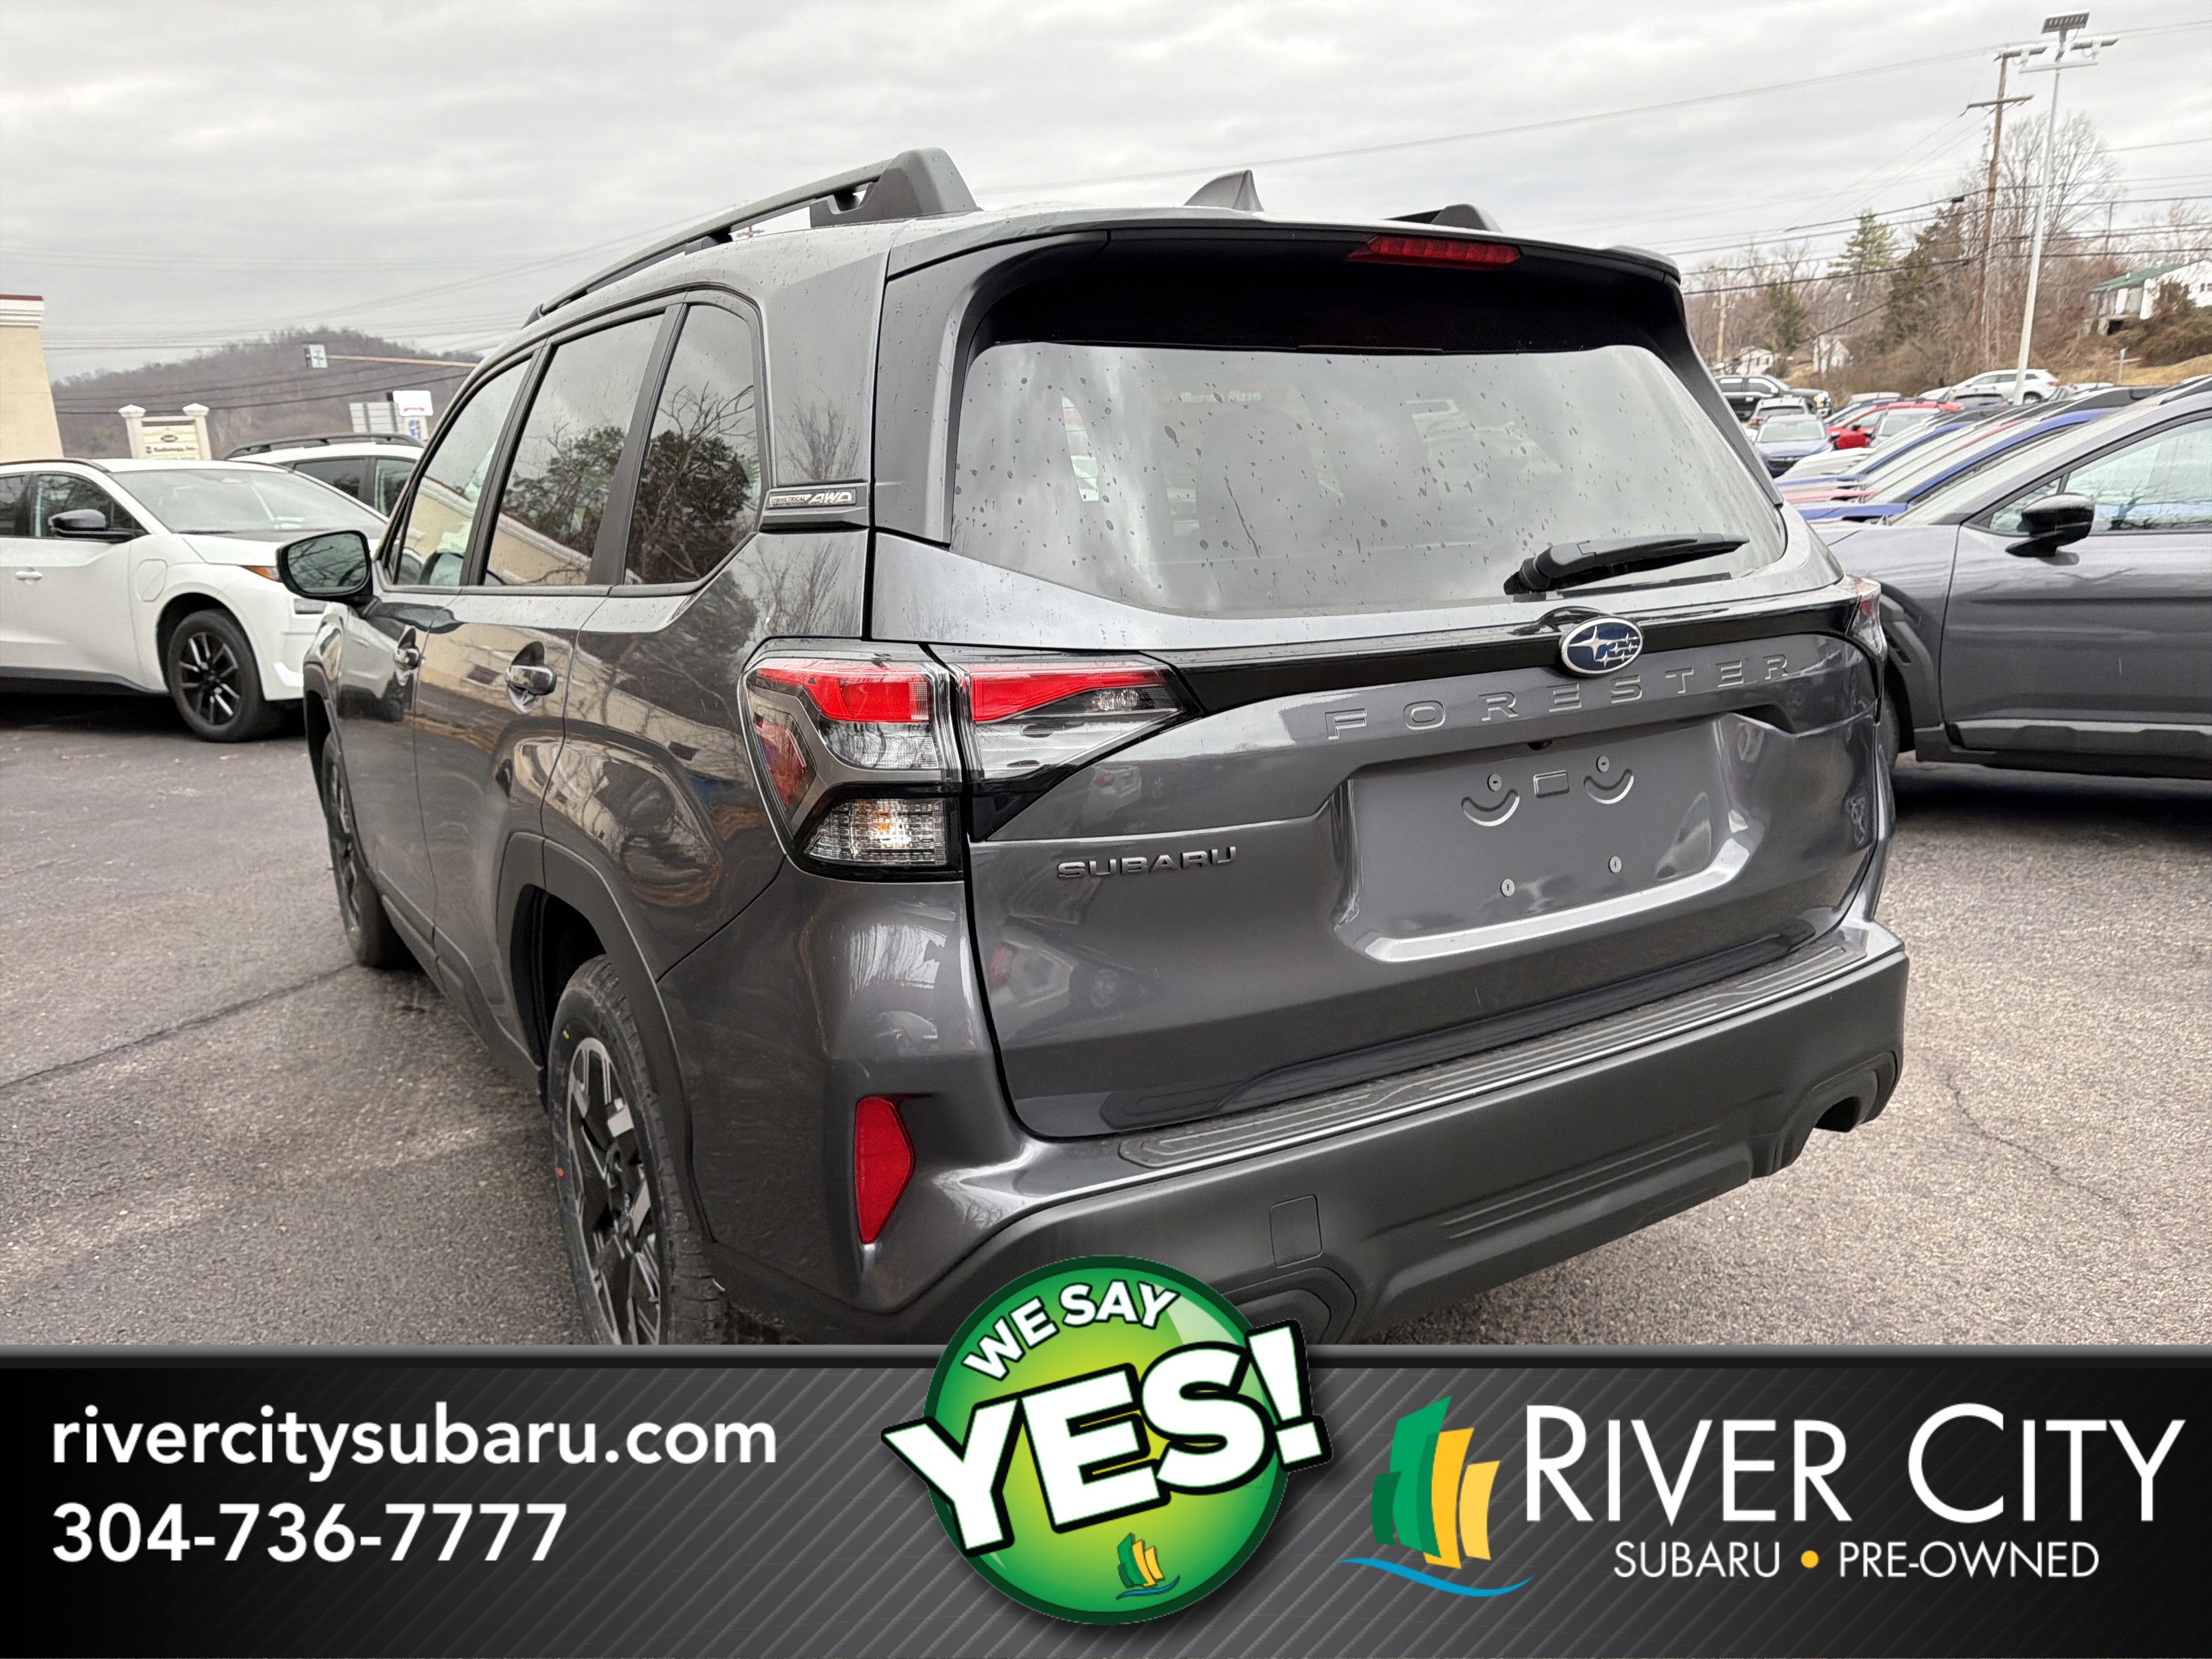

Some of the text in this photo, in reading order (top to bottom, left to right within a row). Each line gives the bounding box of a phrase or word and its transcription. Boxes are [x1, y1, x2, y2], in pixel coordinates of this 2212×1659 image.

[808, 492, 852, 504] AWD
[1324, 654, 1790, 741] FORESTER
[1057, 846, 1236, 878] SUBARU
